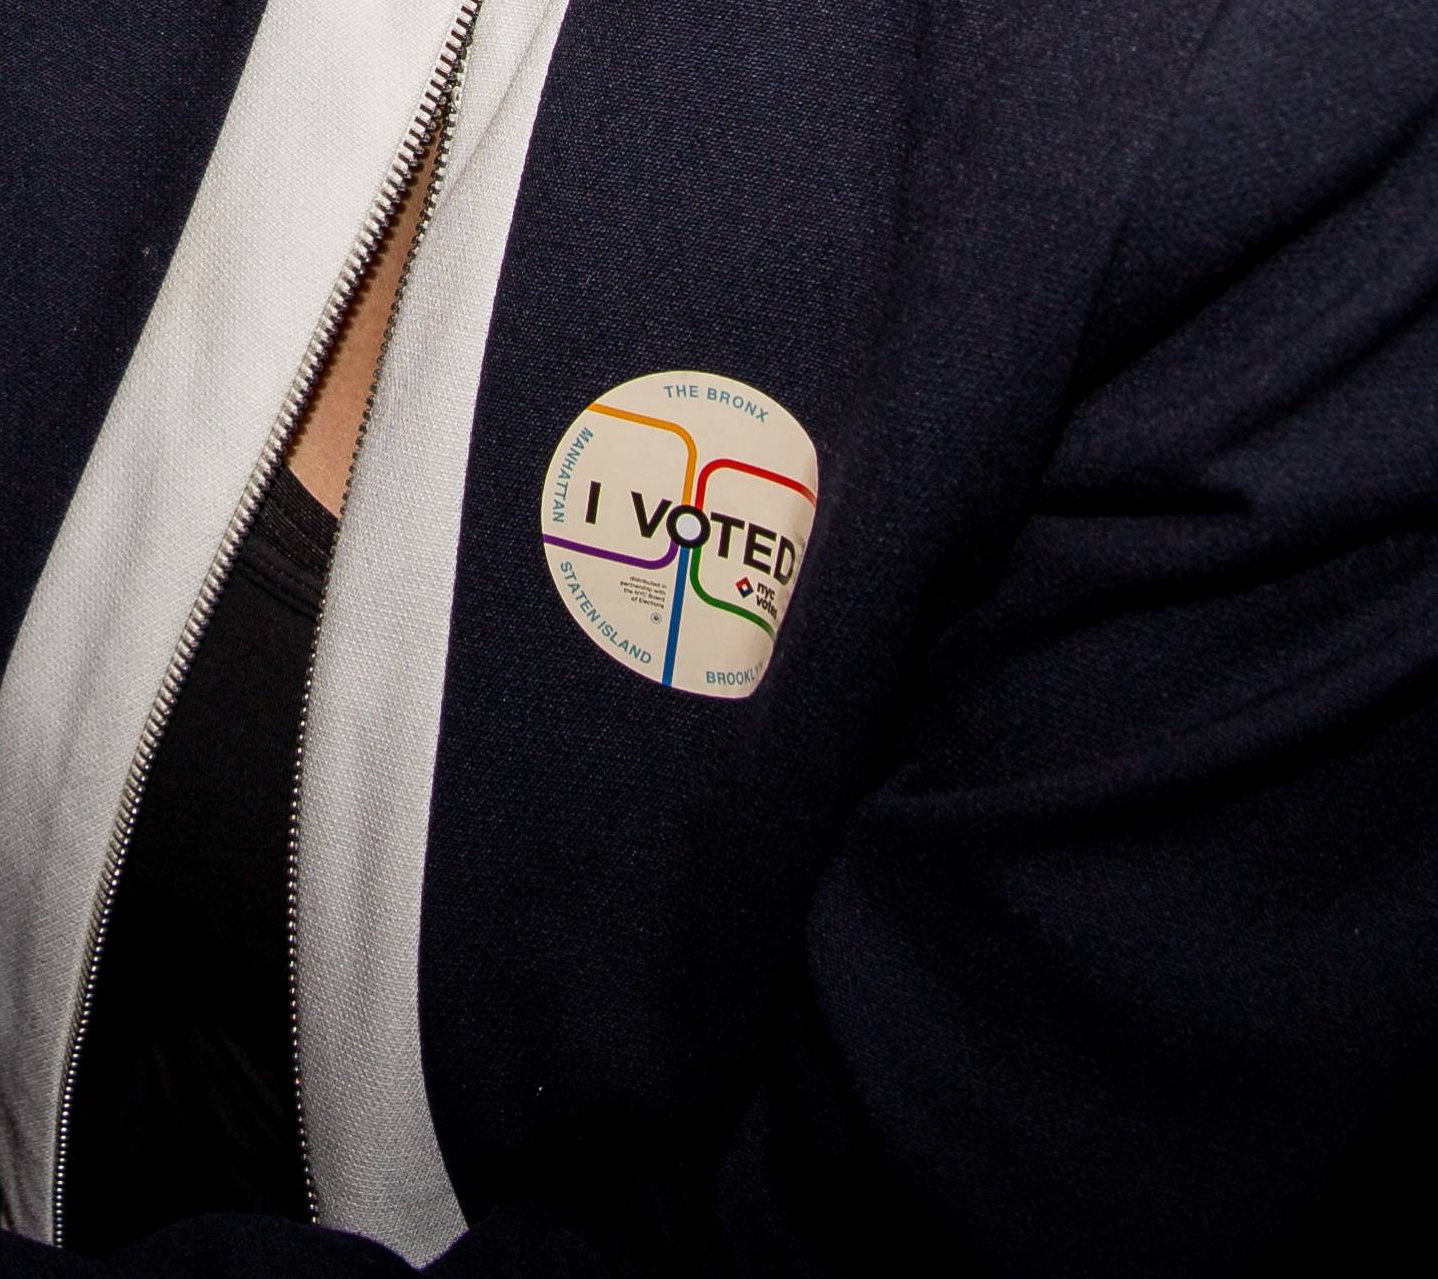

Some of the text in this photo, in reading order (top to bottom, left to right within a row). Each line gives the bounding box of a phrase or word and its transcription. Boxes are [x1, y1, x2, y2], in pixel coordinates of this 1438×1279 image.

[663, 384, 770, 424] THE BRONX
[552, 426, 595, 523] MANHATTAN
[585, 480, 797, 587] I VOTED
[560, 561, 652, 665] STATEN ISLAND
[756, 582, 776, 601] nyc
